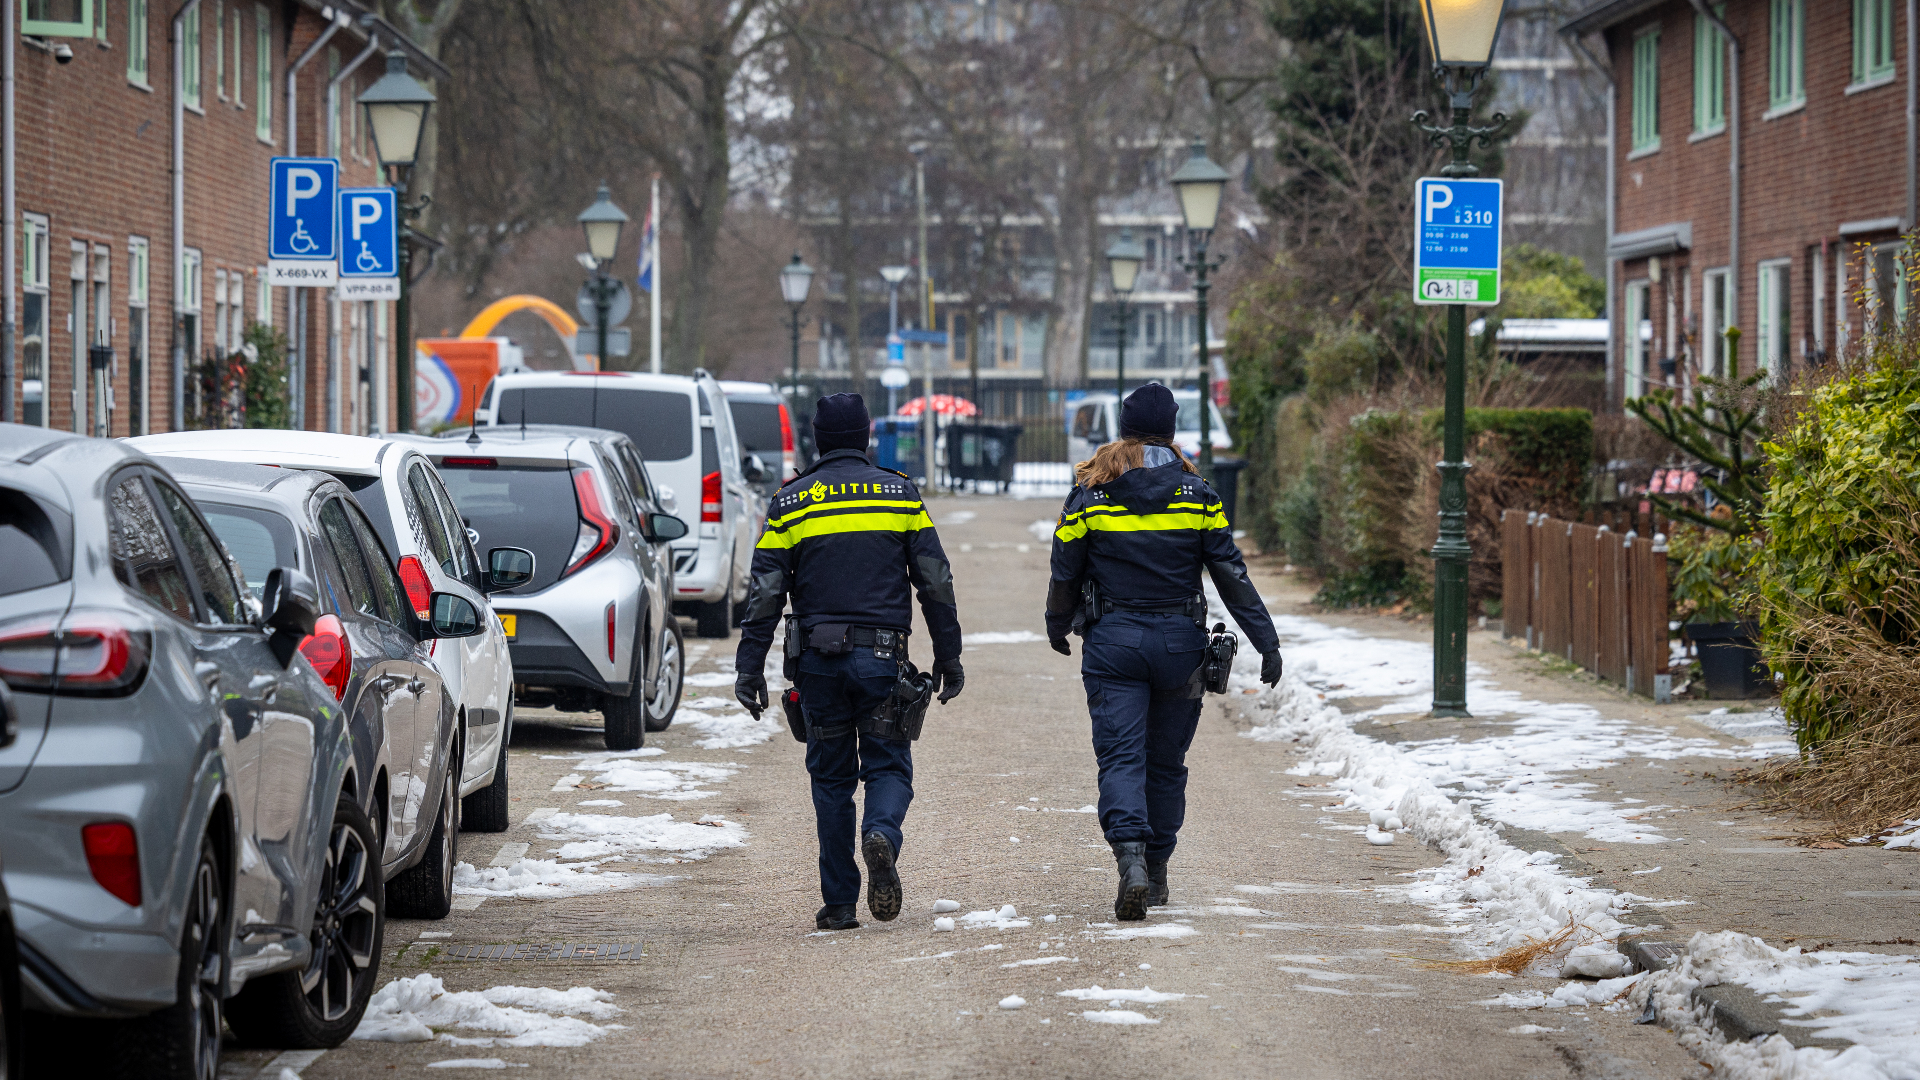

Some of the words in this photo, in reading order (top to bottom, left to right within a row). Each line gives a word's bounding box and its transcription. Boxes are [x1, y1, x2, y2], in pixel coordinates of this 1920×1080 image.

[286, 167, 322, 217] P
[1425, 184, 1454, 223] P
[352, 196, 382, 240] P
[1463, 210, 1493, 225] 310
[276, 268, 328, 279] X-669-VX
[798, 480, 882, 502] POLITIE
